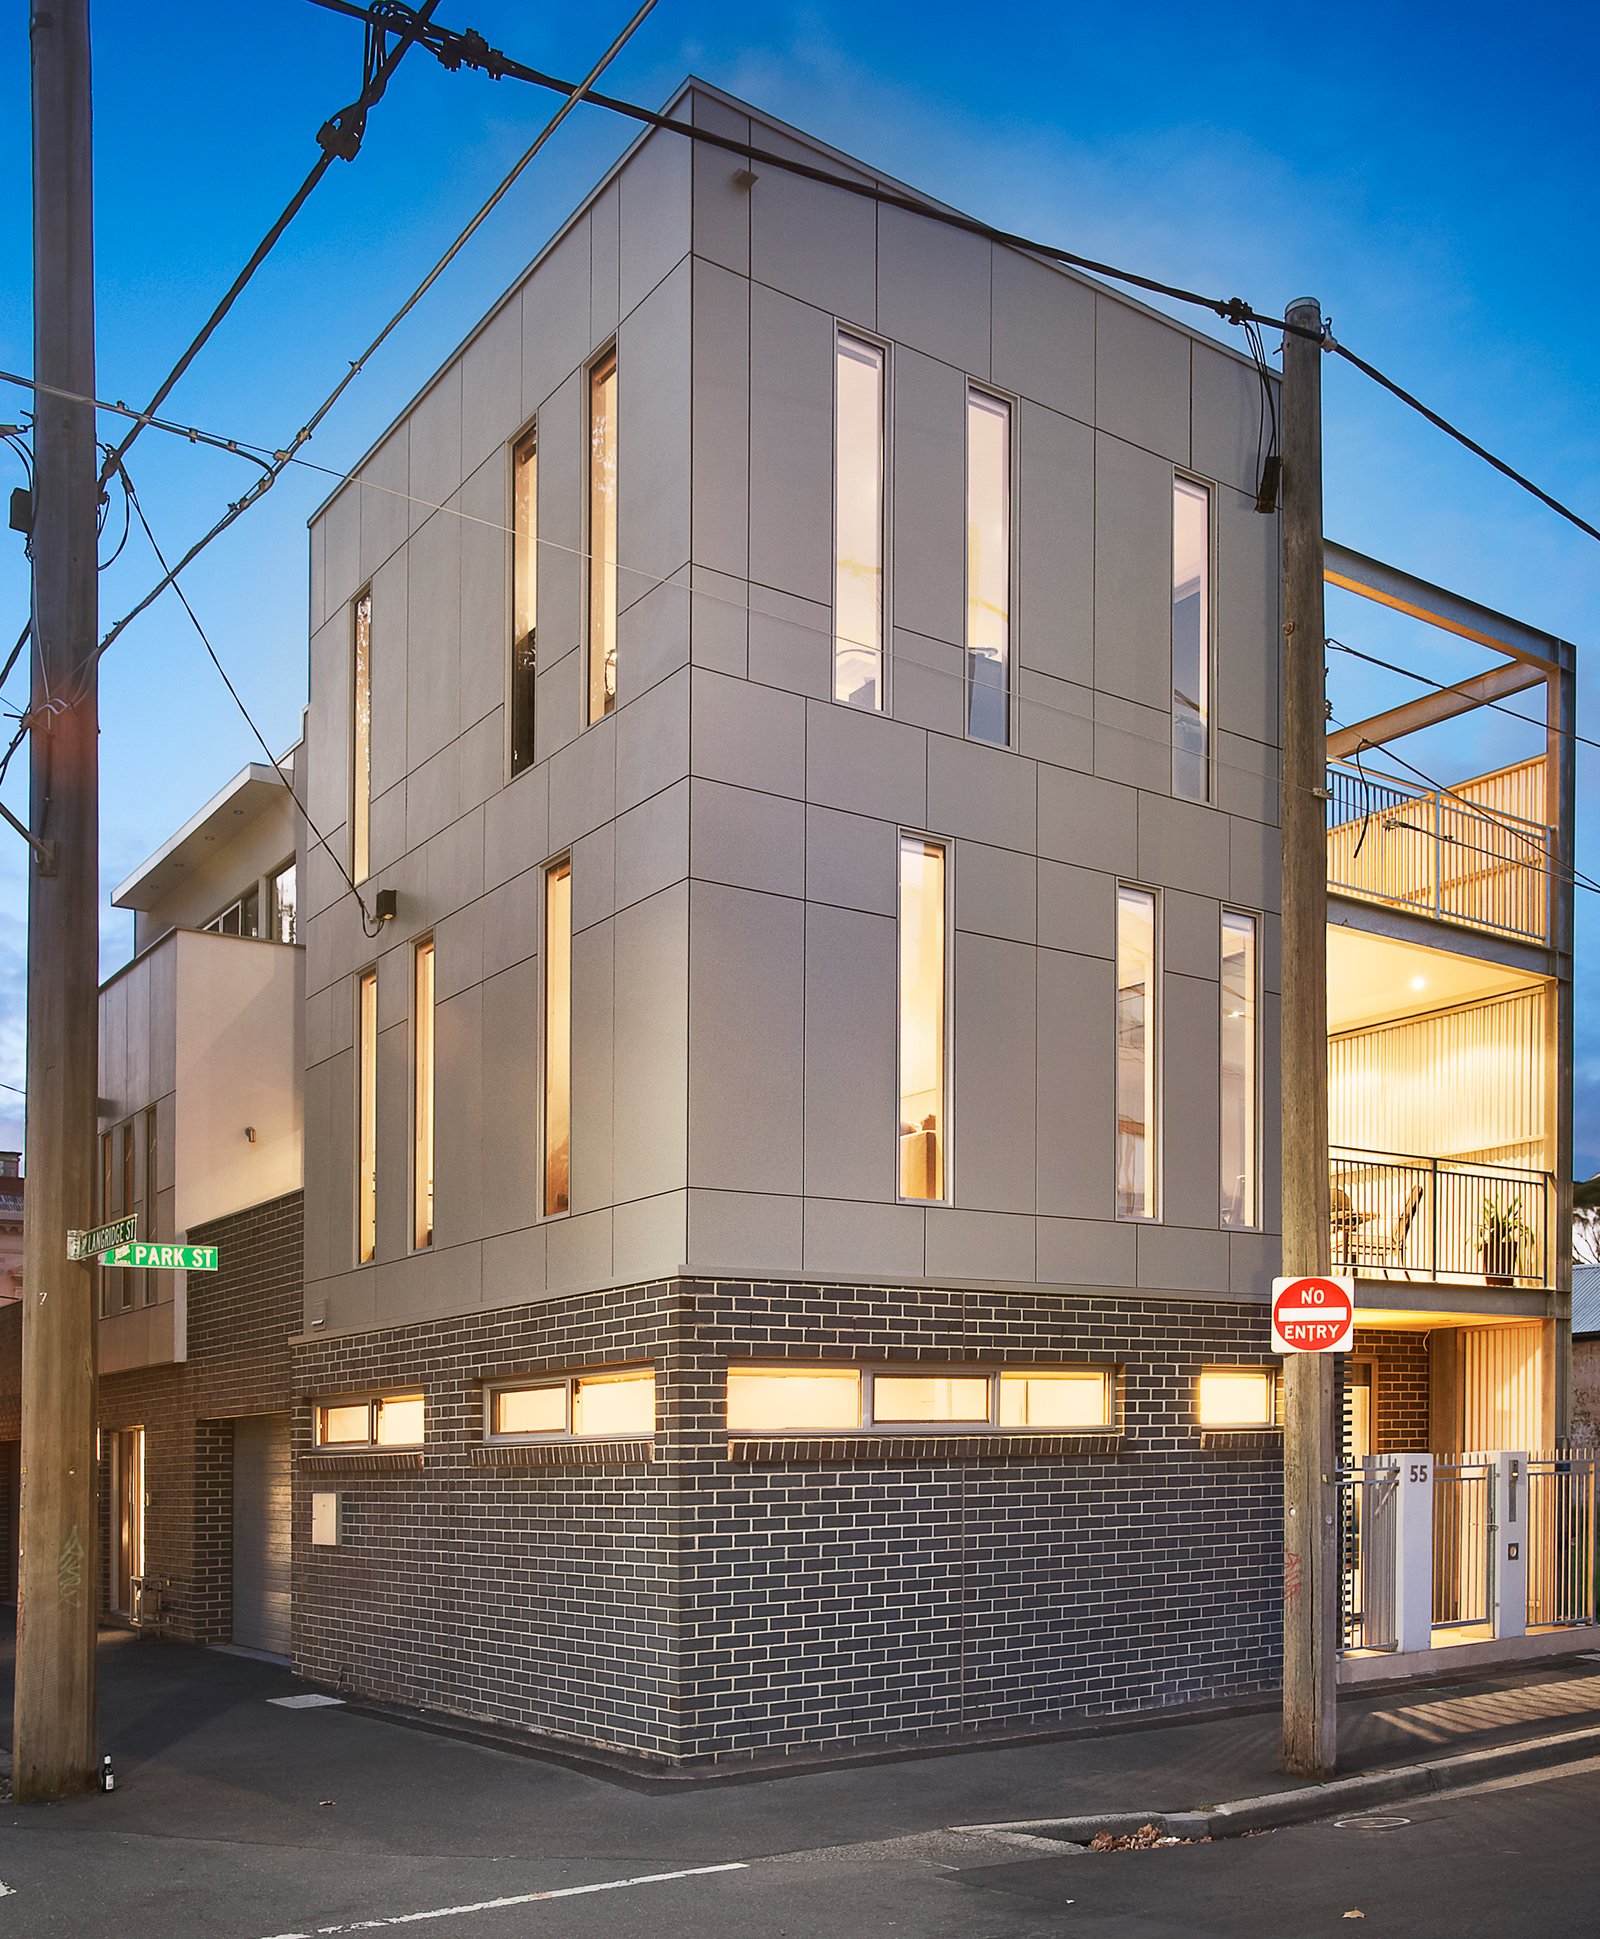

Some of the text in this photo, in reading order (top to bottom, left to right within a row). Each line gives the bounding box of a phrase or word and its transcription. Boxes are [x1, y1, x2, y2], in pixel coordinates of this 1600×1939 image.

[87, 1219, 135, 1253] LANGRIDGE ST
[135, 1246, 213, 1268] PARK ST
[1301, 1288, 1325, 1305] NO
[1284, 1324, 1340, 1341] ENTRY
[1410, 1464, 1428, 1483] 55
